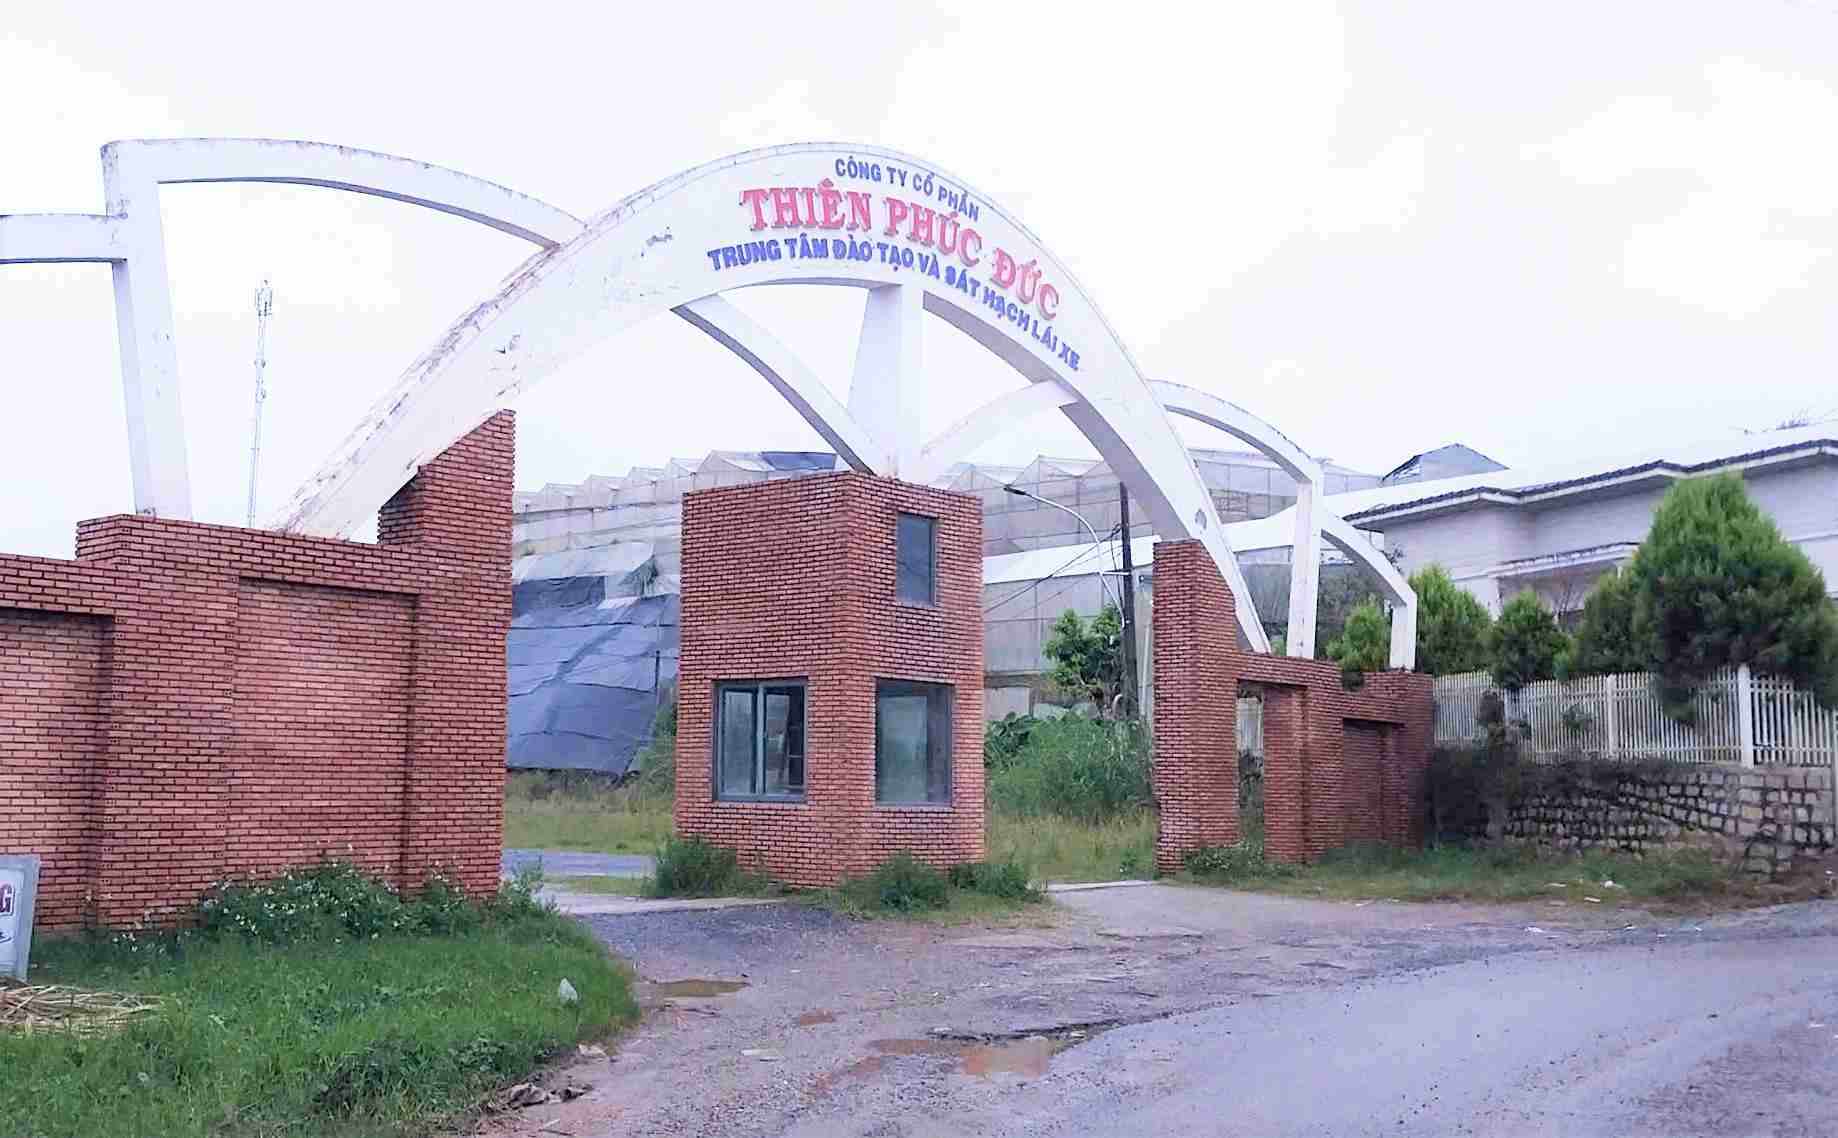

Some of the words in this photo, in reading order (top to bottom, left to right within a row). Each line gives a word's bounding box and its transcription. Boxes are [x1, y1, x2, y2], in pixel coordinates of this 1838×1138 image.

[835, 155, 881, 181] CÔNG
[886, 166, 907, 187] TY
[707, 239, 782, 271] TRUNG
[784, 232, 829, 259] TÂM
[832, 234, 873, 262] ĐÀO
[876, 242, 914, 272] TẠO
[917, 252, 941, 279] VÀ
[983, 286, 1031, 331] HẠCH
[1031, 319, 1058, 353] LÁI
[1057, 342, 1081, 371] XE
[739, 178, 872, 232] THIÊN
[883, 196, 982, 267] PHÚC
[990, 247, 1059, 321] ĐỨC
